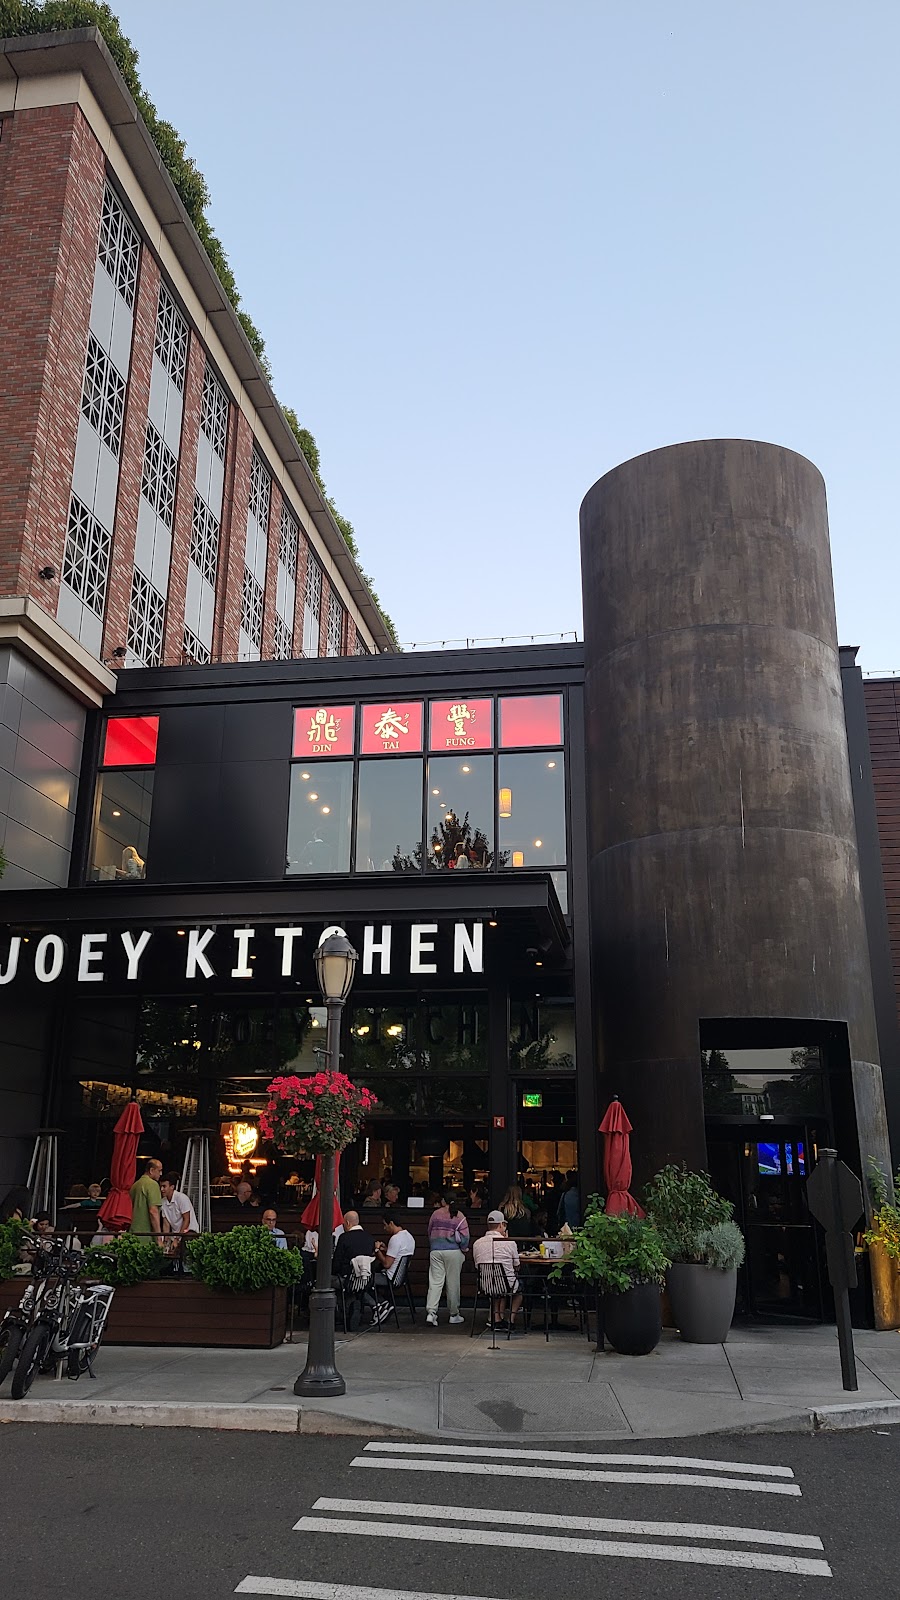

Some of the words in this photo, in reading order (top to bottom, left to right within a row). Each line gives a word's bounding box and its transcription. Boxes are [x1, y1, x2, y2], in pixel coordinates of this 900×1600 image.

[307, 708, 338, 742] 鼎
[374, 707, 409, 739] 泰
[446, 703, 471, 736] 豐
[404, 713, 410, 727] タイ
[312, 744, 332, 752] DIN
[383, 741, 399, 749] TAI
[446, 738, 475, 746] FUNG
[0, 931, 153, 984] JOEY
